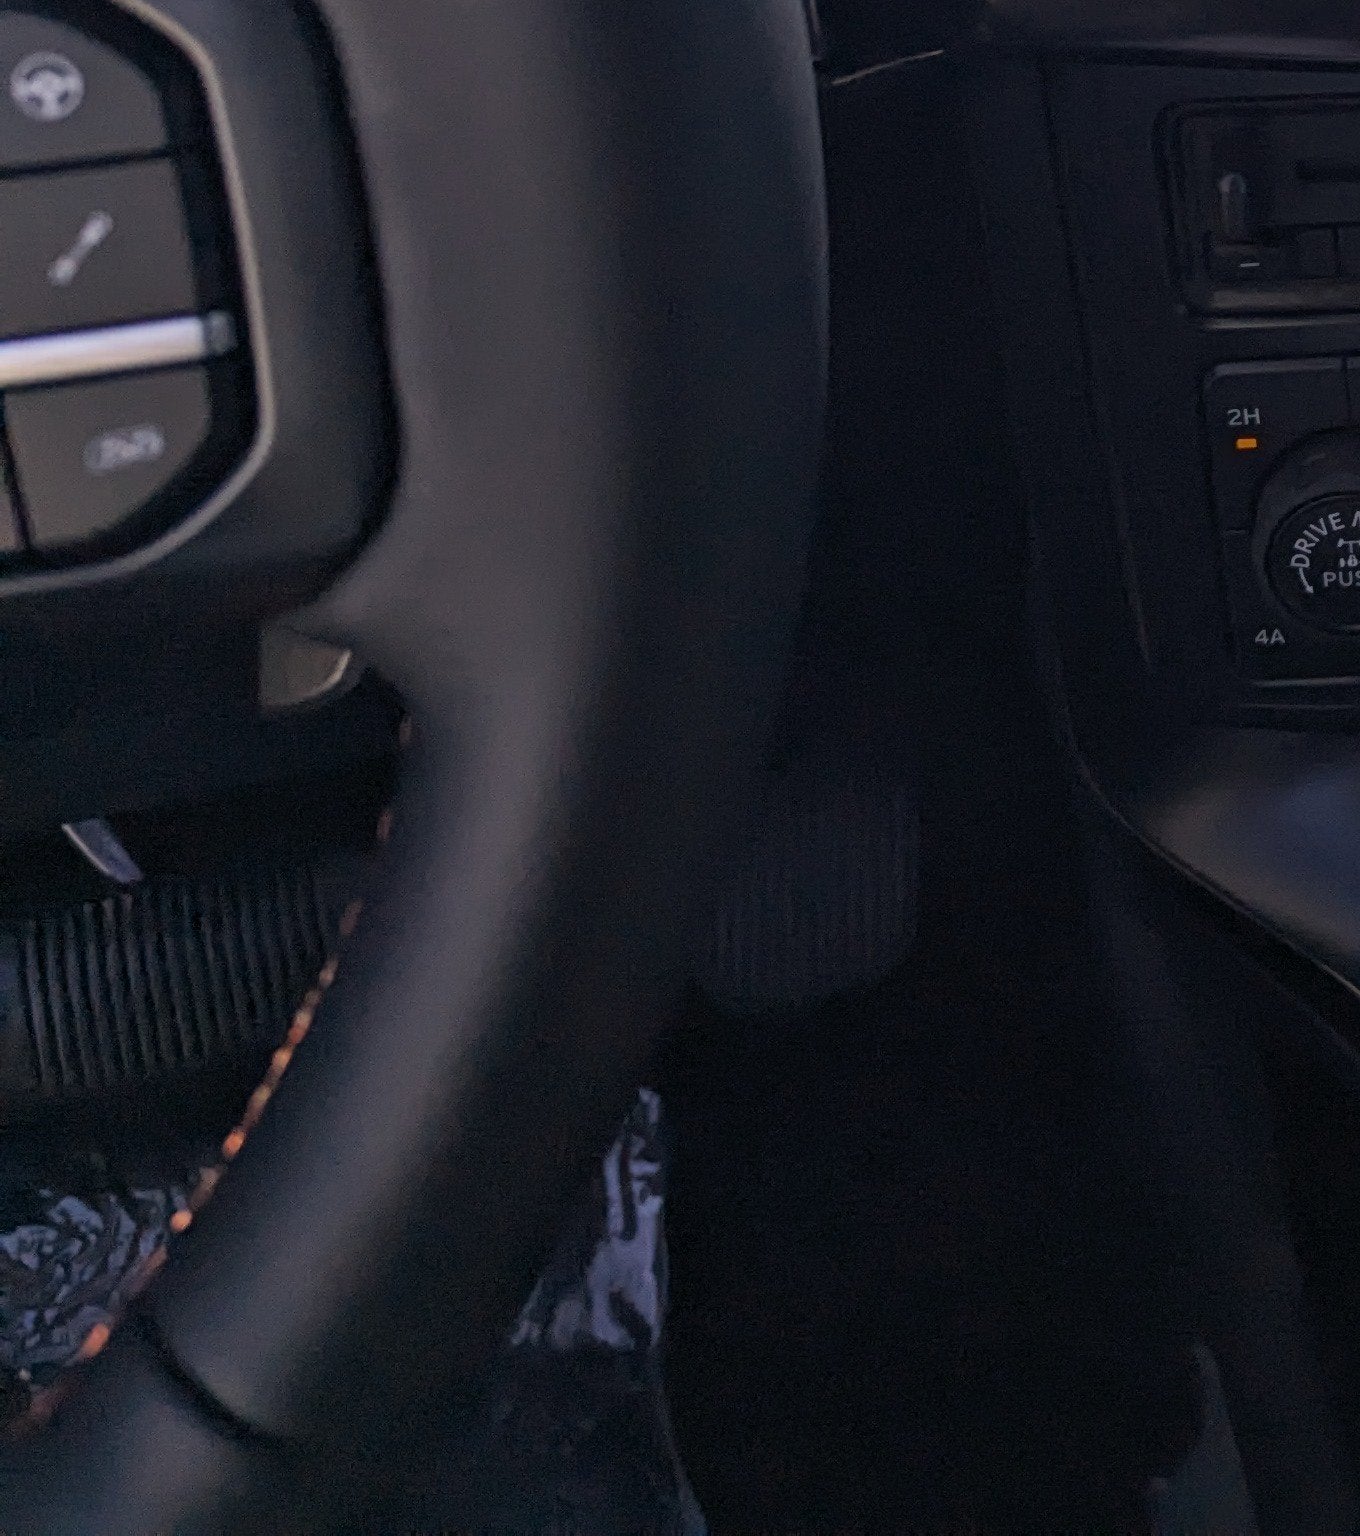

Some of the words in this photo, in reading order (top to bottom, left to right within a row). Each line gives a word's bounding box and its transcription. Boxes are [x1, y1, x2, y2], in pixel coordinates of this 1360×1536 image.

[1227, 407, 1261, 426] 2H
[1290, 512, 1346, 569] DRIVE
[1254, 629, 1285, 645] 4A
